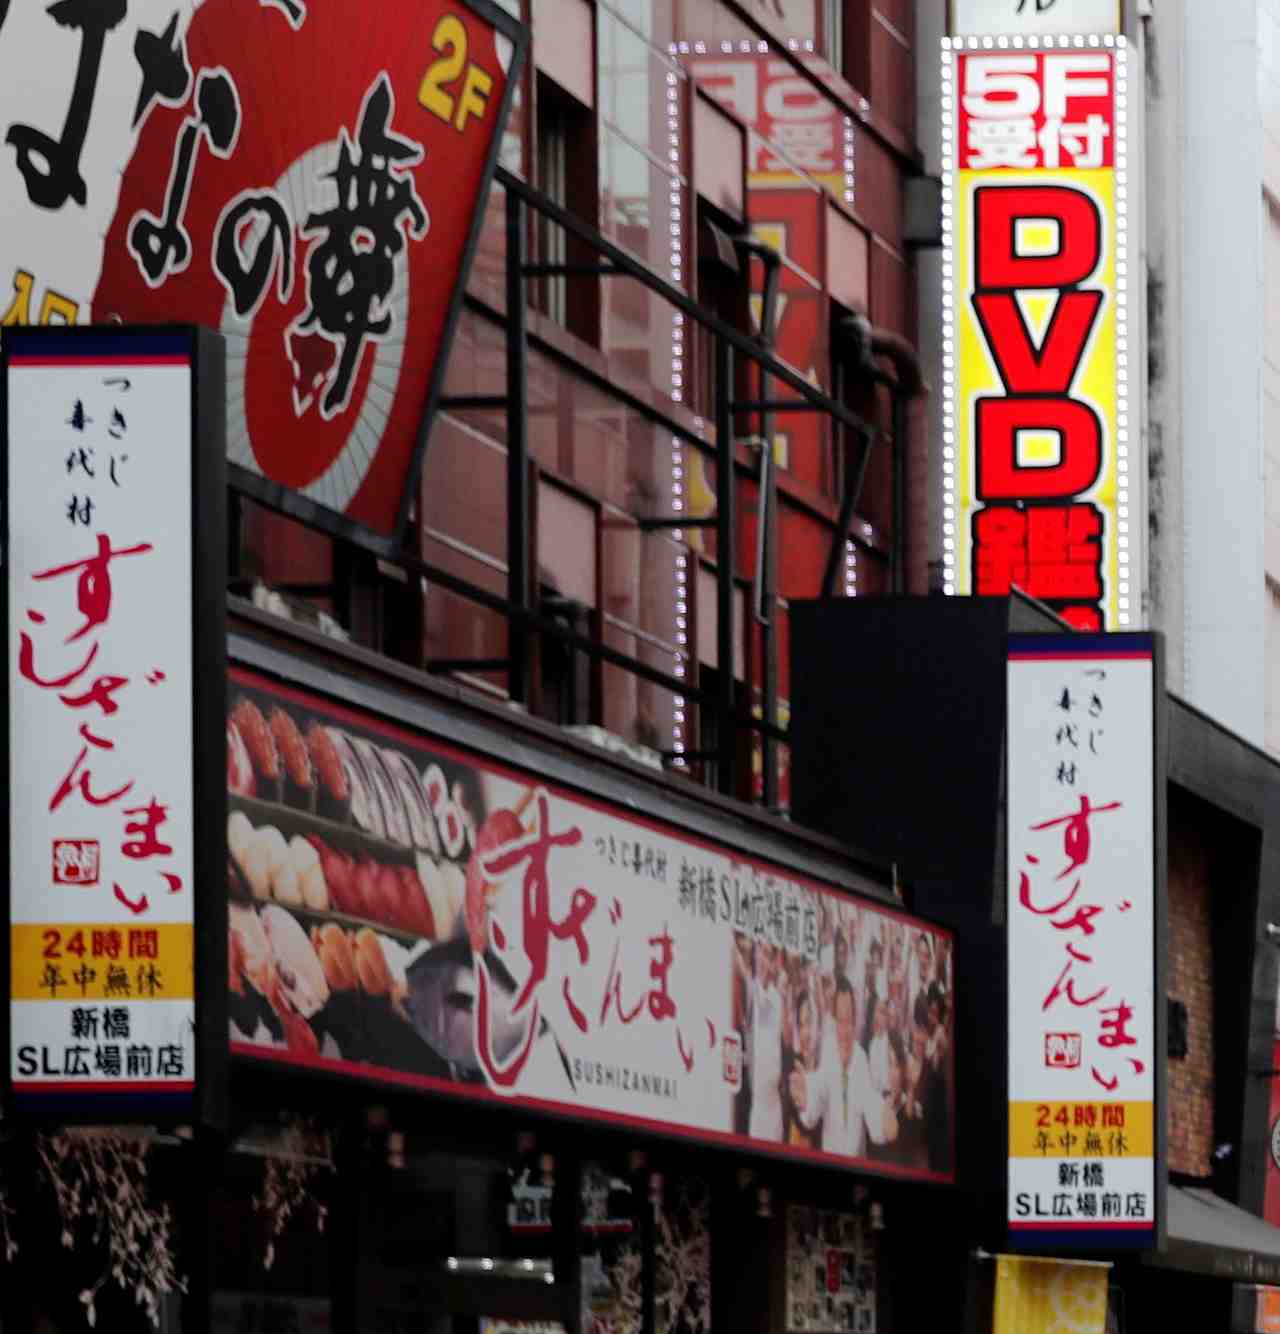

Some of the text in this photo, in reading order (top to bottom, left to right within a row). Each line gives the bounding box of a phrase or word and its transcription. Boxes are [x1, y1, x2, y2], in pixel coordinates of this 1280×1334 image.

[418, 14, 492, 132] 2F
[962, 54, 1110, 117] 5F
[966, 117, 1110, 169] 受付
[972, 185, 1104, 634] DVD鑑
[41, 928, 160, 961] 24時間
[37, 964, 164, 998] 年中無休
[70, 1006, 132, 1038] 新橋
[17, 1043, 185, 1078] SL広場前店
[1034, 1105, 1126, 1129] 24時間
[1032, 1131, 1130, 1155] 年中無休
[1058, 1161, 1105, 1189] 新橋
[1015, 1192, 1147, 1219] SL広場前店
